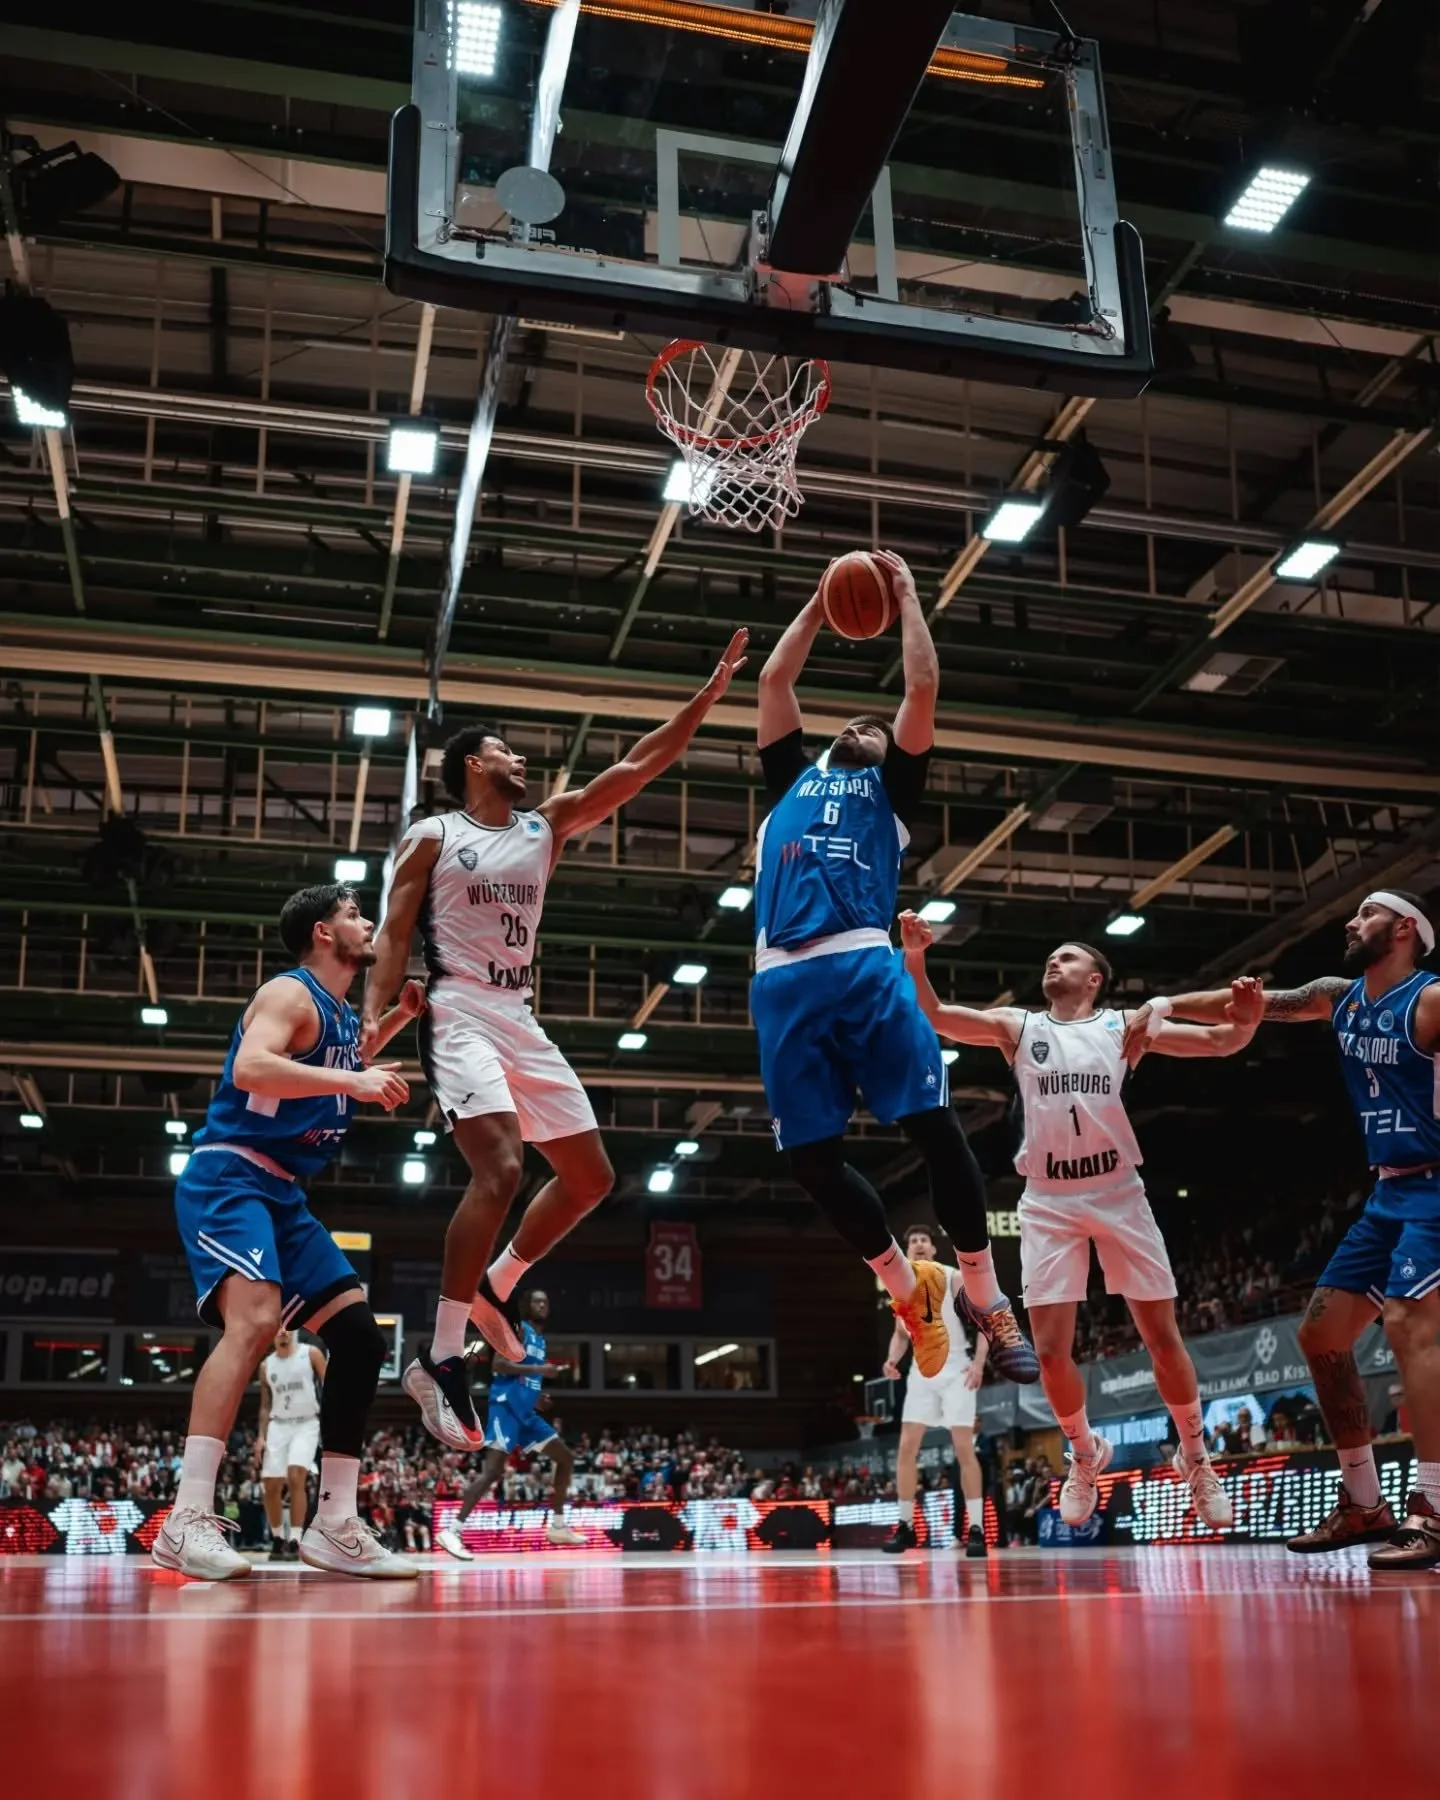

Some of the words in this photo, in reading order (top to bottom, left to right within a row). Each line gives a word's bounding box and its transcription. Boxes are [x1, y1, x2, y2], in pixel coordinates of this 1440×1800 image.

[823, 800, 841, 825] 6
[501, 912, 528, 947] 26
[1069, 1104, 1081, 1136] 1
[1360, 1109, 1417, 1135] TEL
[652, 1244, 694, 1282] 34
[0, 1271, 114, 1304] op.net
